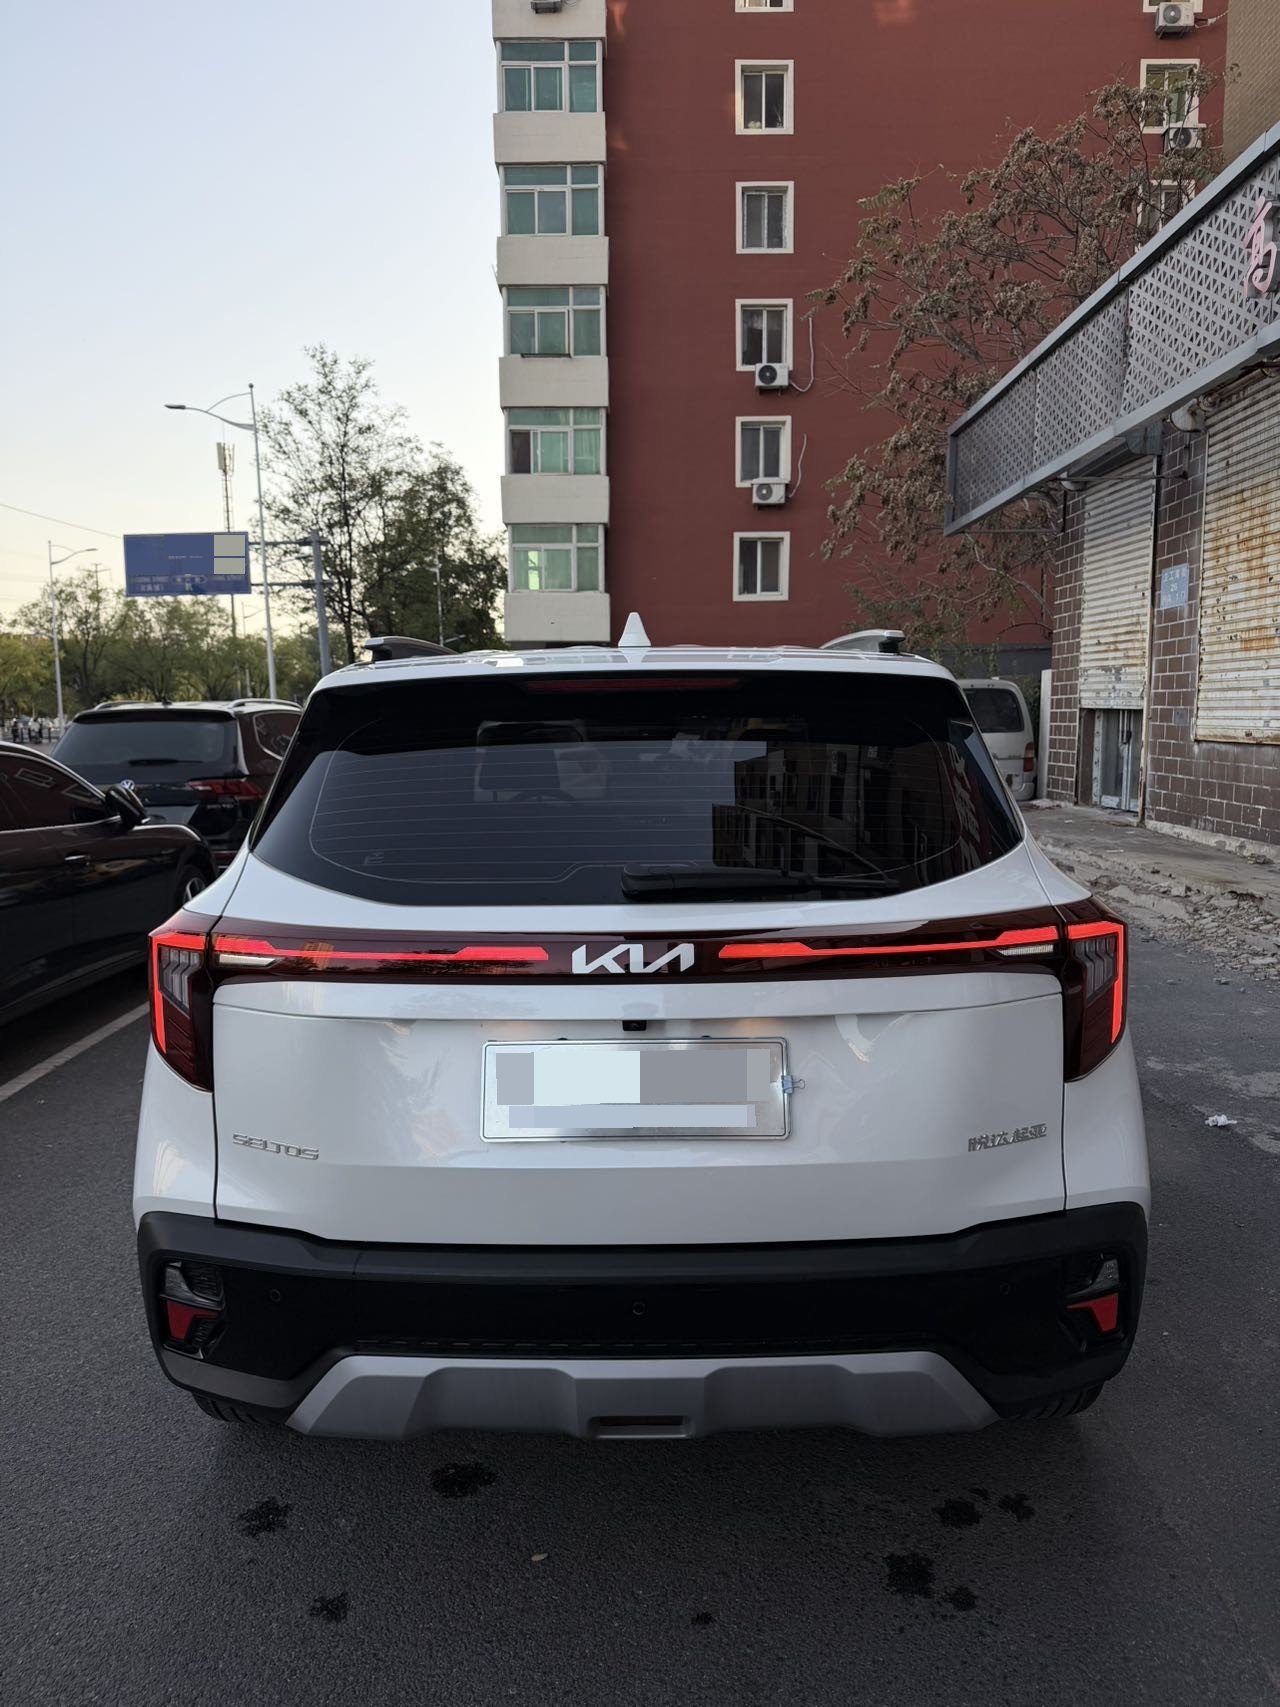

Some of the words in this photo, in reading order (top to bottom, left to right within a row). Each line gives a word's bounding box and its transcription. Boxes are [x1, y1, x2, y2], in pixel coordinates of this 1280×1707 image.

[572, 943, 695, 974] KIA
[232, 1132, 319, 1160] SELTOS
[968, 1123, 1047, 1152] 悦达起亚
